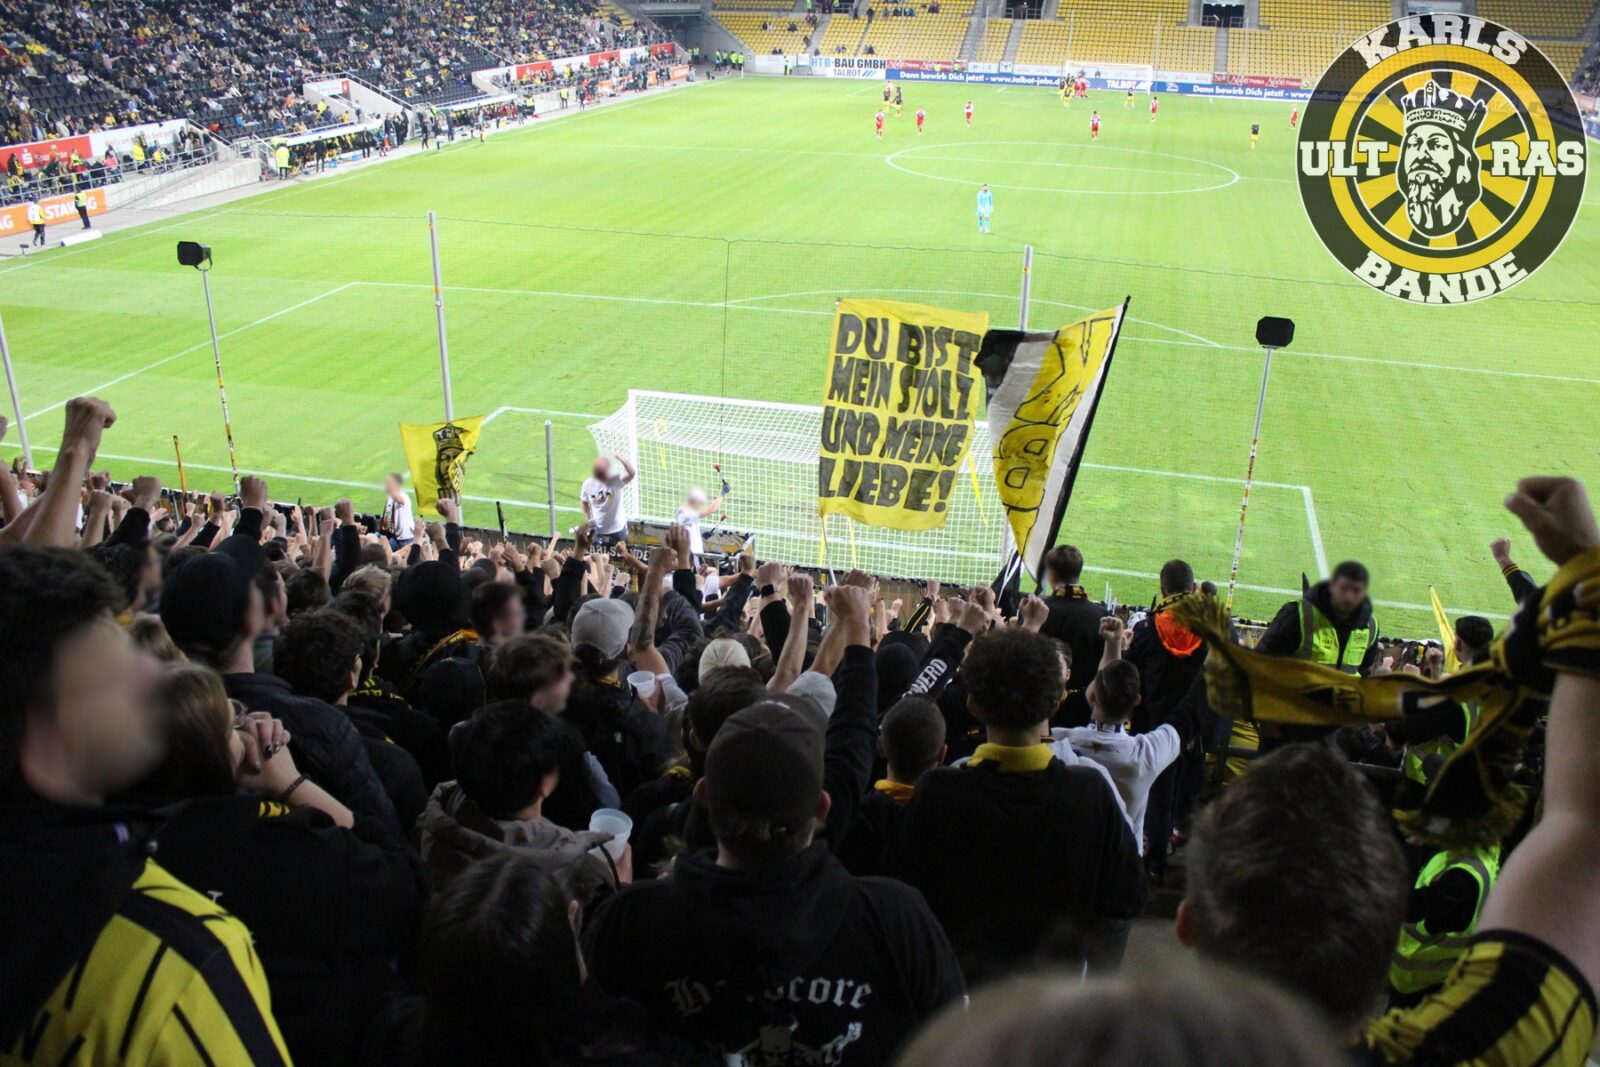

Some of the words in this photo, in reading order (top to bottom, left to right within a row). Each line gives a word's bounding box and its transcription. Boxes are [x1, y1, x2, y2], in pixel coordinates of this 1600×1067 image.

[833, 69, 861, 77] TALBOT
[857, 59, 886, 69] GMBH
[900, 71, 919, 79] Dann
[921, 72, 947, 80] bewirb
[948, 73, 965, 81] Dich
[966, 74, 984, 83] jetzt!
[991, 76, 1061, 86] www.talbot-jobs.d
[1193, 85, 1214, 93] Dann
[1215, 85, 1243, 94] bewirb
[1245, 86, 1262, 95] Dich
[1264, 88, 1284, 98] jetzt!
[836, 313, 889, 360] DU
[897, 322, 981, 375] BIST
[828, 356, 895, 409] MEIN
[898, 365, 974, 420] STOLZ
[821, 406, 880, 456] UND
[879, 417, 968, 466] MEINE
[819, 456, 956, 513] LIEBE!
